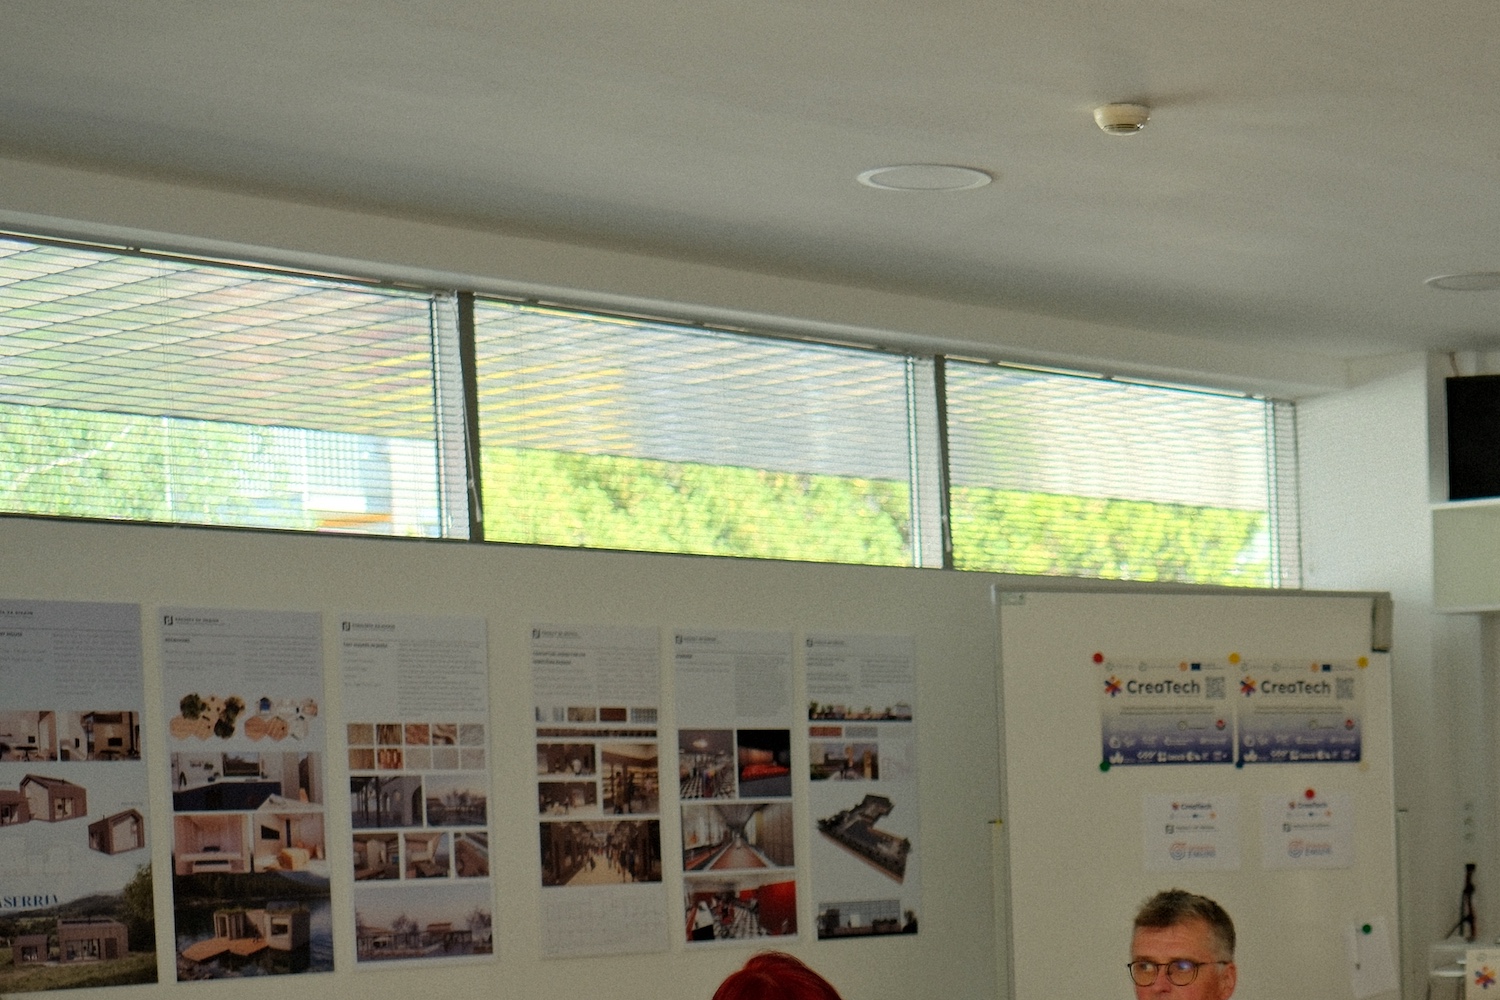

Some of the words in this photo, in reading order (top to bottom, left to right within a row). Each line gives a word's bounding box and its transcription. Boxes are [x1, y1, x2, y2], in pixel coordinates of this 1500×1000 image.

[1126, 678, 1201, 695] CreaTech
[1260, 679, 1331, 695] CreaTech
[0, 893, 59, 909] SERRIA
